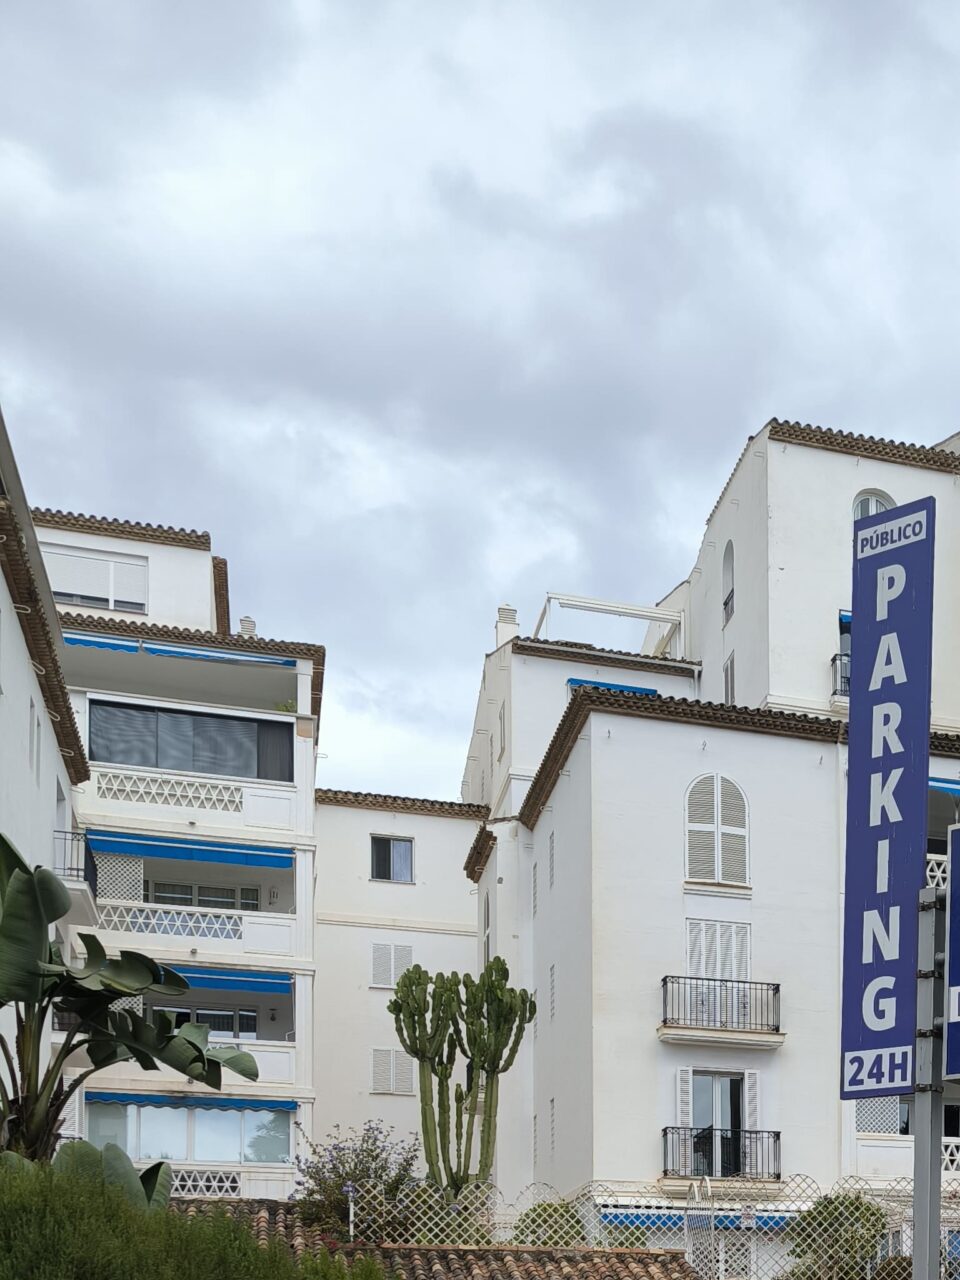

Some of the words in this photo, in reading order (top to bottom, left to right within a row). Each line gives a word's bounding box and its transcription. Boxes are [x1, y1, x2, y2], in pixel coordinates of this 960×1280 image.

[860, 519, 924, 554] PÚBLICO
[862, 563, 908, 1032] PARKING
[848, 1050, 909, 1087] 24H
